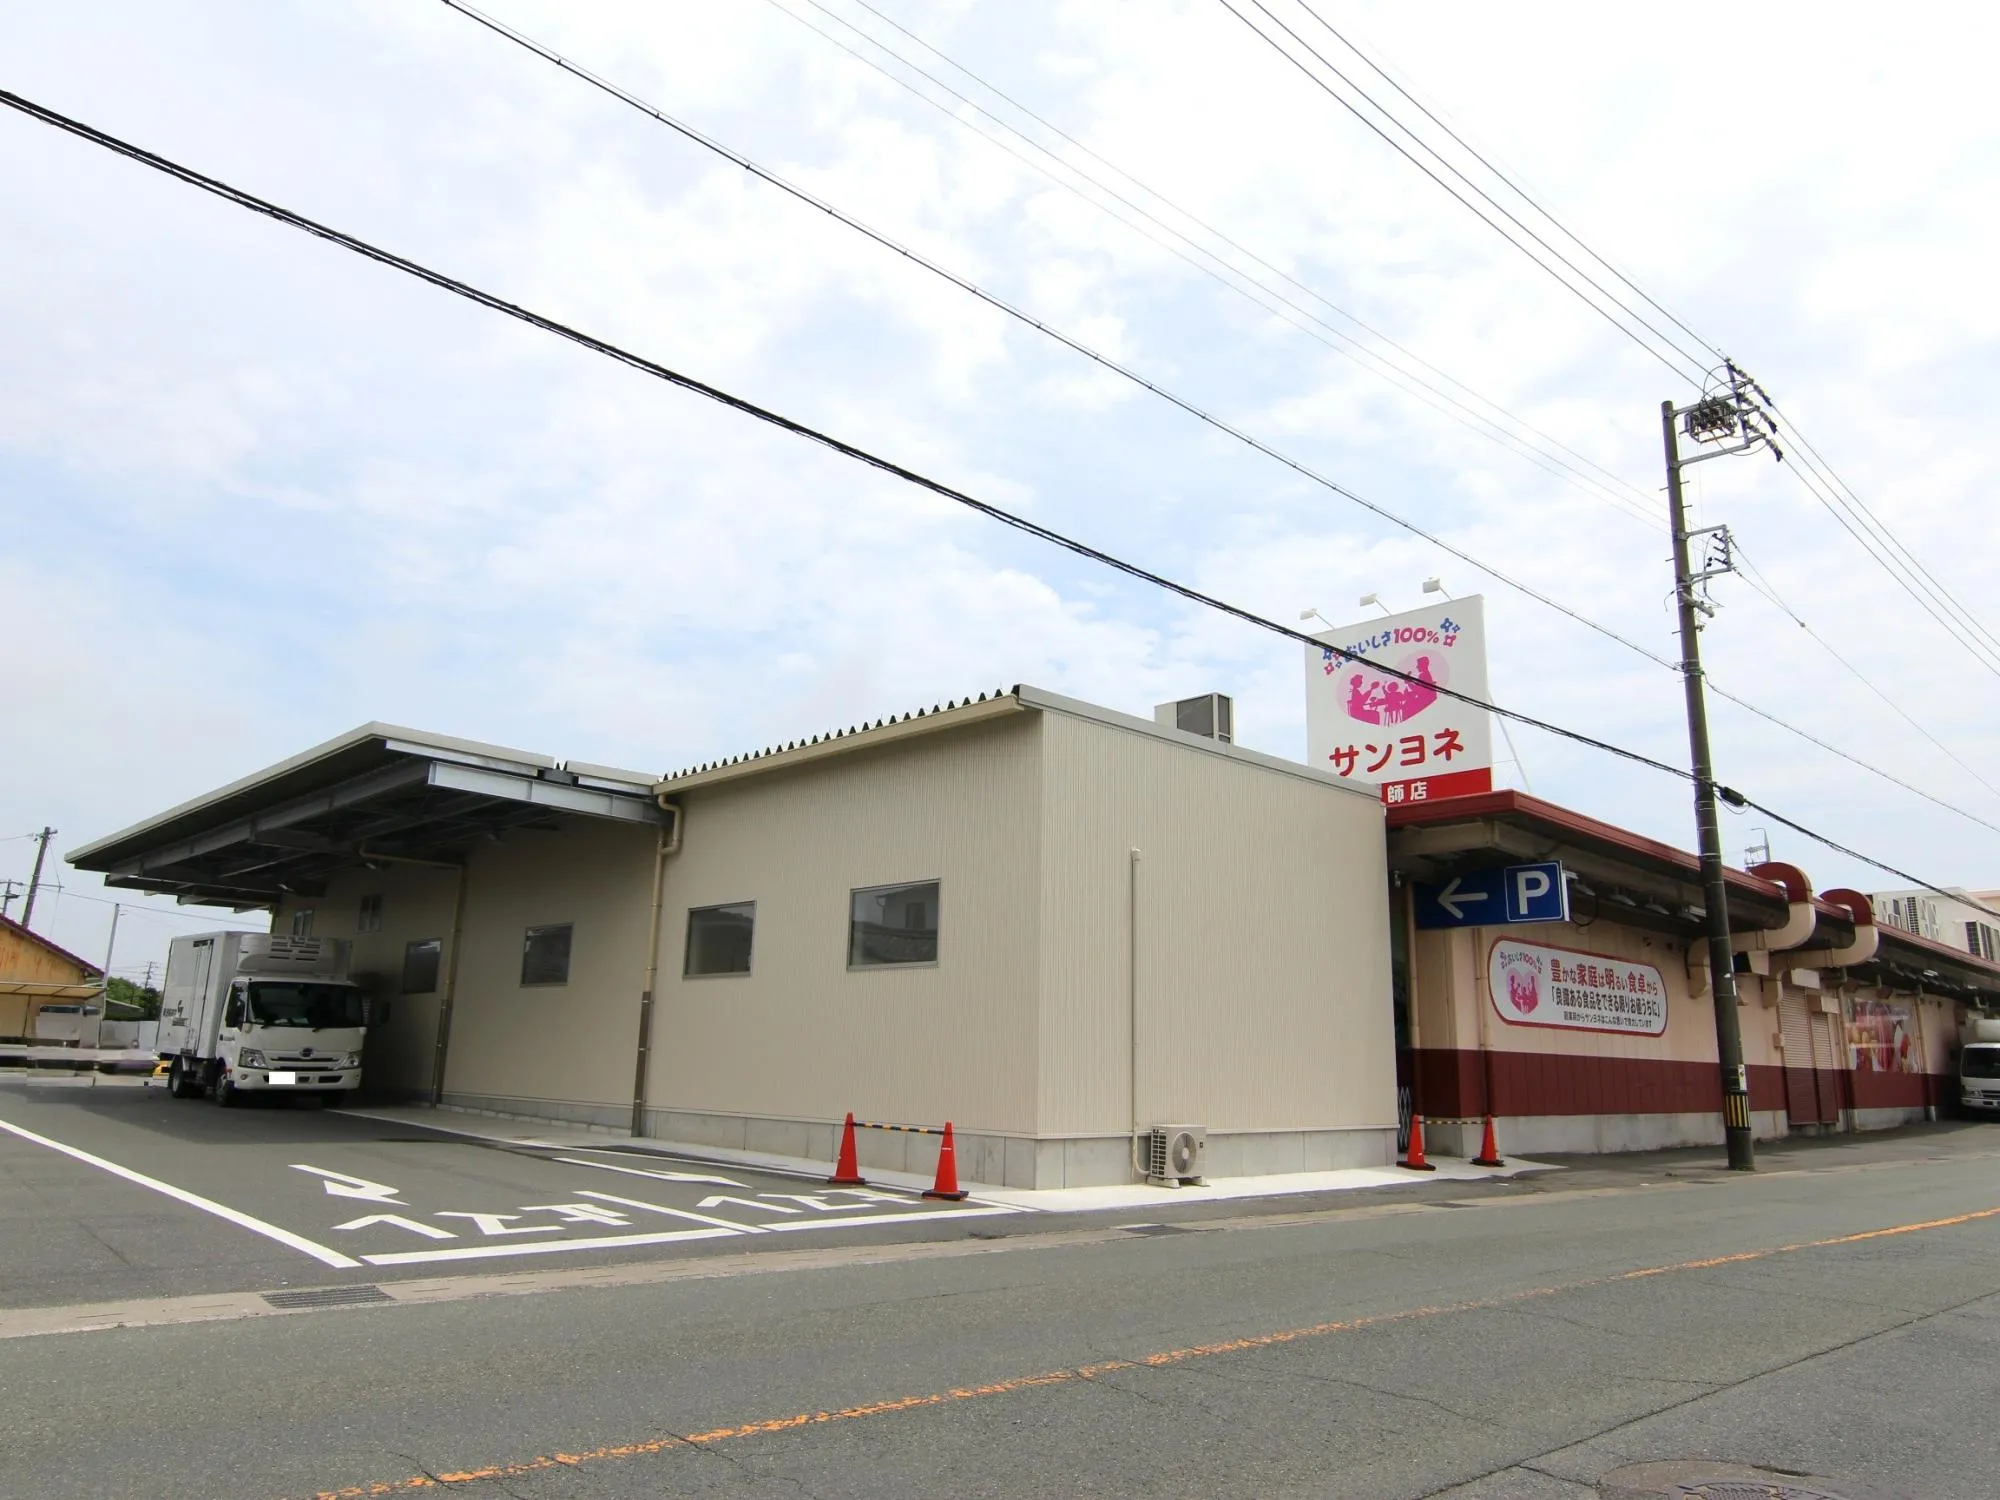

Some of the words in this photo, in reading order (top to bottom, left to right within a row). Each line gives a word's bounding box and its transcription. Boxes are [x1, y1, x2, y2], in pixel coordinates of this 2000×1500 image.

[1329, 728, 1464, 776] サンヨネ
[1517, 870, 1550, 915] P
[1550, 959, 1658, 996] 豊かな家庭は明るい食卓から
